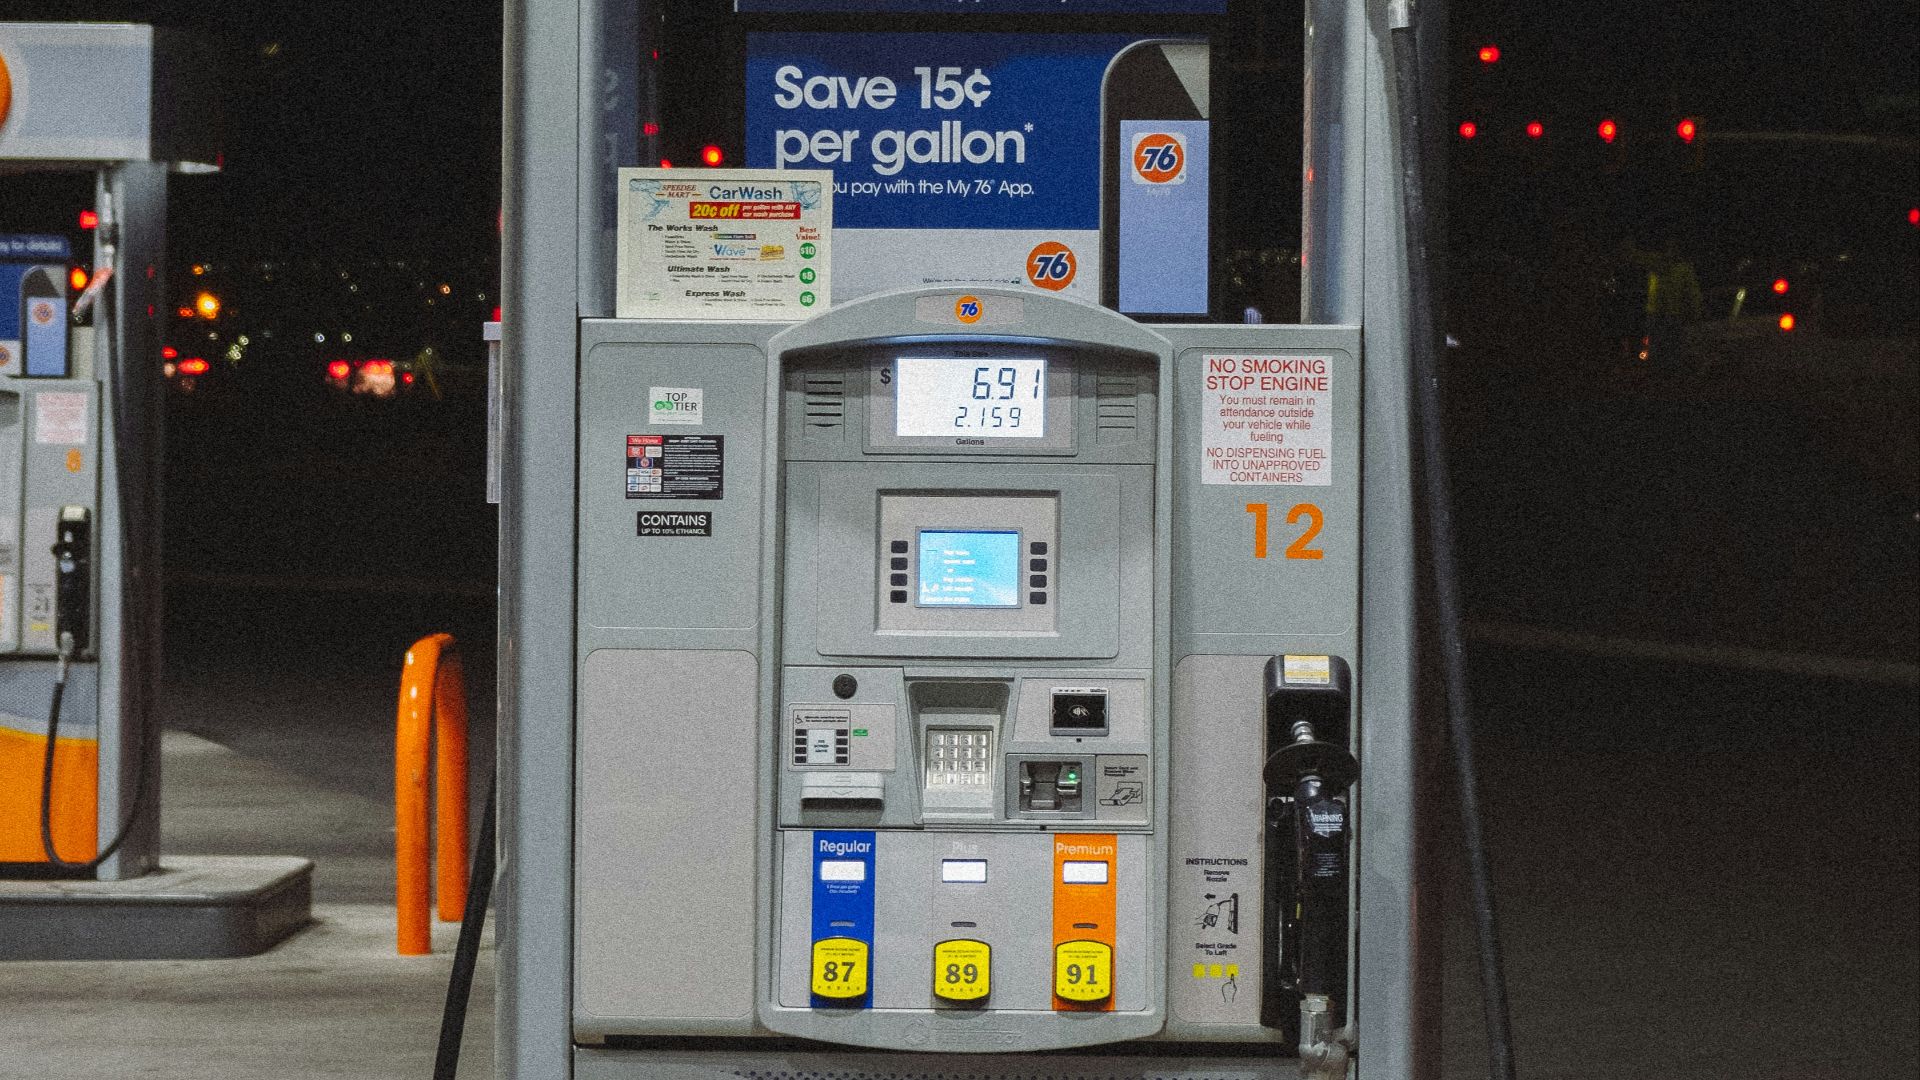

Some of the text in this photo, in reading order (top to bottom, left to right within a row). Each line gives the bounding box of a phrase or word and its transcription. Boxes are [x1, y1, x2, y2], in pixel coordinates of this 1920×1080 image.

[774, 65, 991, 110] Save 15¢
[776, 130, 859, 170] per
[1141, 143, 1177, 172] 76
[851, 182, 881, 197] pay
[884, 179, 915, 194] with
[918, 179, 943, 194] the
[947, 180, 971, 197] My
[998, 180, 1034, 198] App.
[720, 204, 740, 217] off
[1033, 252, 1070, 281] 76
[685, 290, 720, 298] Express
[960, 302, 978, 317] 76
[1210, 359, 1325, 374] NO SMOKING
[880, 367, 891, 385] $
[972, 367, 1040, 400] 6.91
[1207, 376, 1328, 391] STOP ENGINE
[665, 392, 687, 401] TOP
[1220, 395, 1315, 405] You must remain in
[674, 402, 698, 411] TIER
[1220, 407, 1314, 417] attendance outside
[955, 406, 1021, 428] 2.159
[1223, 420, 1311, 431] your vehicle while
[956, 438, 984, 446] Gallons
[1250, 431, 1283, 444] fueling
[1207, 448, 1326, 459] NO DISPENSING FUEL
[1212, 460, 1320, 471] INTO UNAPPROVED
[1230, 472, 1303, 482] CONTAINERS
[641, 514, 707, 526] CONTAINS
[1246, 503, 1324, 559] 12
[820, 839, 871, 856] Regular
[1056, 842, 1113, 855] Premium
[1185, 858, 1248, 866] INSTRUCTIONS
[823, 961, 855, 982] 87
[946, 964, 978, 984] 89
[1067, 964, 1097, 985] 91
